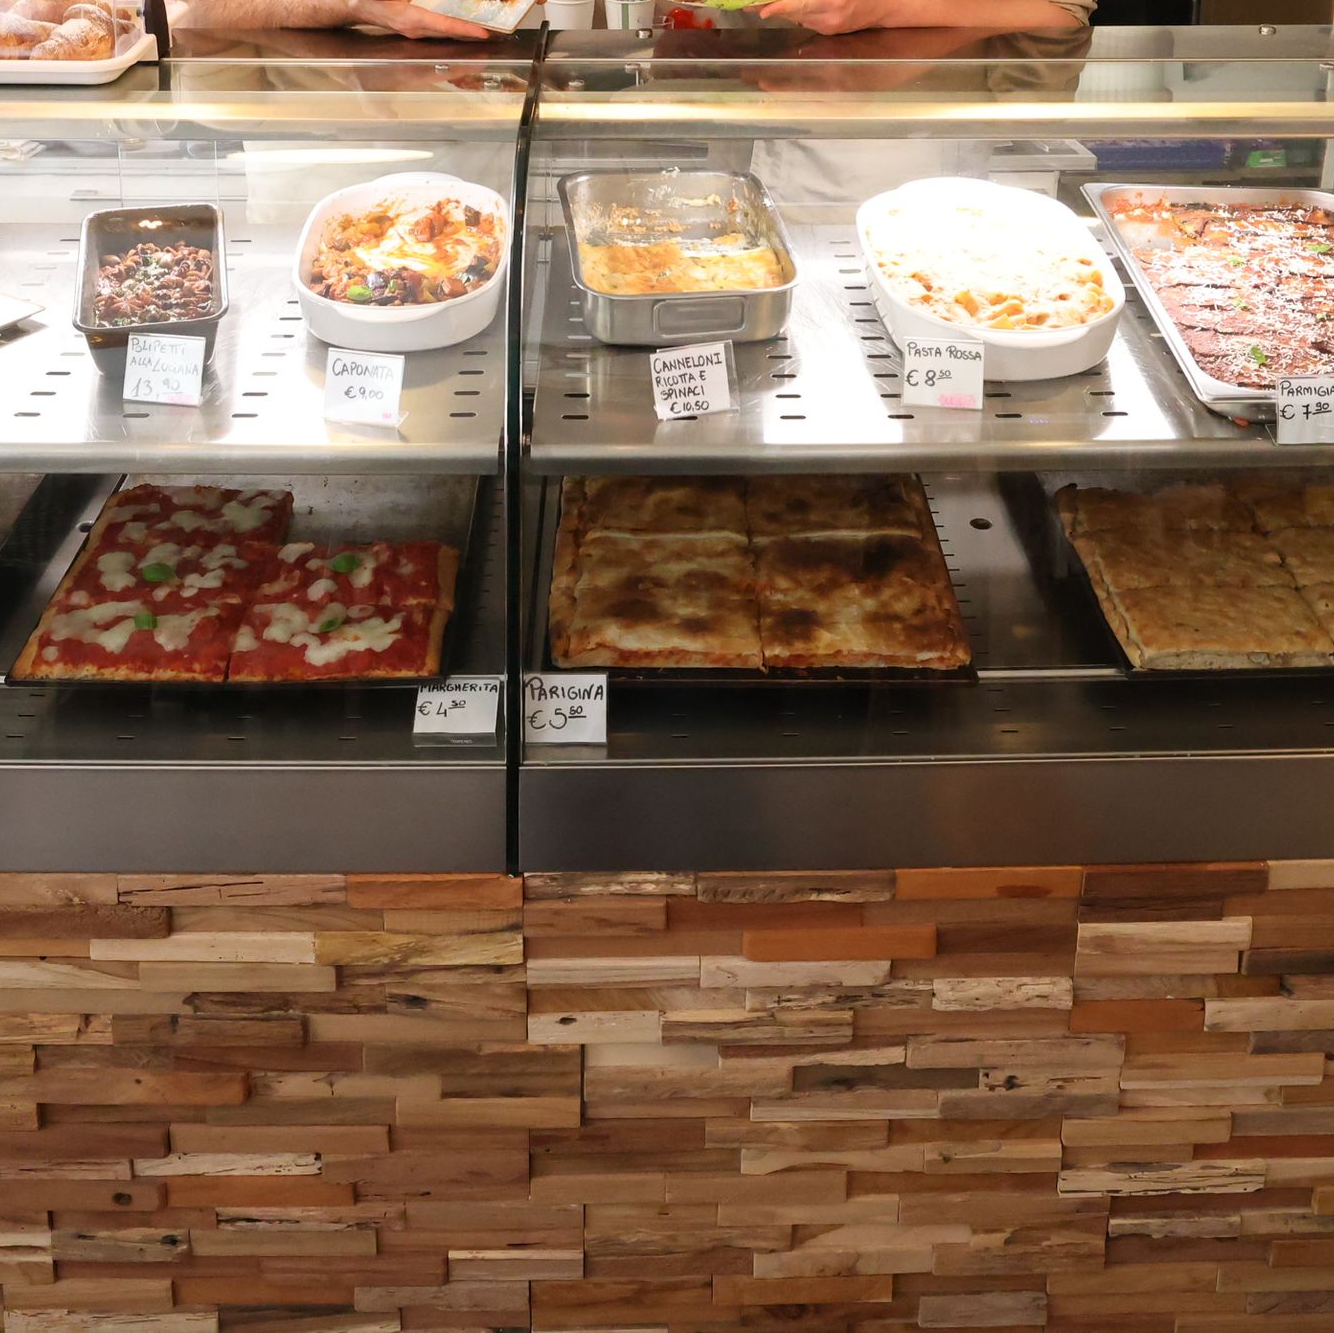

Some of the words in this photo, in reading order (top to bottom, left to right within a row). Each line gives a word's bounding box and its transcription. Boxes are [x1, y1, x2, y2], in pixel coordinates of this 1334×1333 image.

[907, 341, 944, 358] PASTA
[949, 344, 982, 361] ROSSA
[332, 359, 394, 380] CAPONATA
[653, 352, 722, 374] CANNELONI
[655, 373, 696, 387] RICOTTA
[699, 370, 706, 381] E
[660, 385, 705, 400] SPINACI
[419, 683, 498, 693] MARGHERITA
[525, 676, 604, 701] PARIGINA
